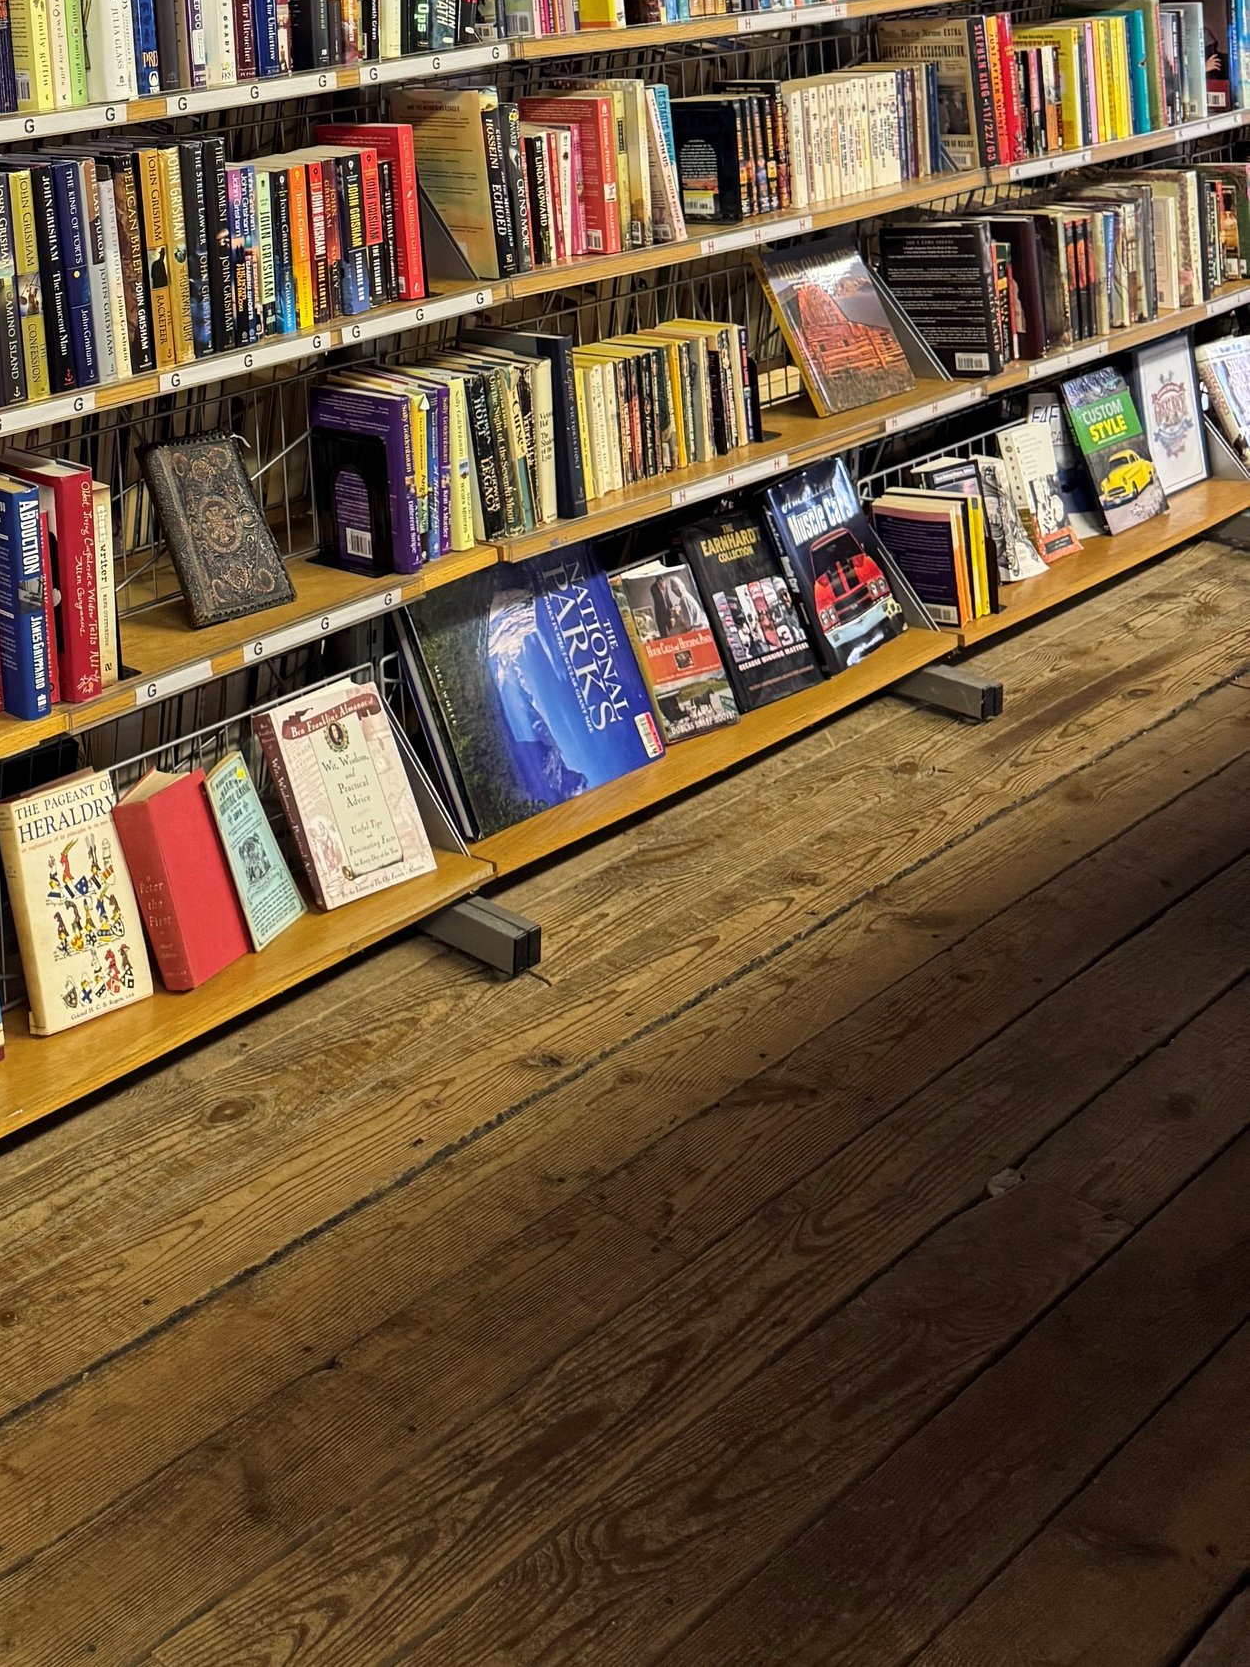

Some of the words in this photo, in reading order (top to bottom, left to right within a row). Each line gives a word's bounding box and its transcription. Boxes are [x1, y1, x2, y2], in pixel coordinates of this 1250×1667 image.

[745, 19, 750, 29] H
[974, 24, 985, 70] STEPHEN
[369, 68, 378, 80] G
[492, 47, 499, 60] G
[250, 86, 259, 98] G
[979, 74, 989, 98] KING
[105, 107, 115, 122] G
[1015, 167, 1021, 176] K
[708, 240, 713, 252] H
[755, 230, 761, 241] H
[416, 309, 424, 322] G
[171, 374, 180, 387] G
[312, 336, 321, 348] G
[891, 418, 897, 427] H
[1082, 399, 1123, 426] CUSTOM
[1088, 414, 1128, 443] STYLE
[680, 491, 686, 502] H
[787, 503, 828, 546] Muscle
[824, 492, 853, 530] Cars
[19, 500, 39, 576] ABDUCTION
[700, 526, 760, 557] EARNHARDT
[718, 546, 753, 564] COLLECTION
[545, 561, 617, 731] PARKS
[565, 562, 631, 723] NATIONAL
[603, 618, 618, 649] THE
[148, 684, 157, 698] G
[321, 618, 329, 630] G
[291, 723, 305, 738] Ben
[306, 709, 338, 733] Franklin's
[338, 700, 366, 718] Almanac
[322, 760, 339, 772] Wit,
[341, 751, 370, 765] Wisdom,
[346, 767, 355, 778] and
[338, 780, 369, 794] Practical
[15, 806, 41, 821] THE
[44, 785, 95, 812] PAGEANT
[347, 794, 371, 808] Advice
[18, 793, 115, 844] HERALDRY
